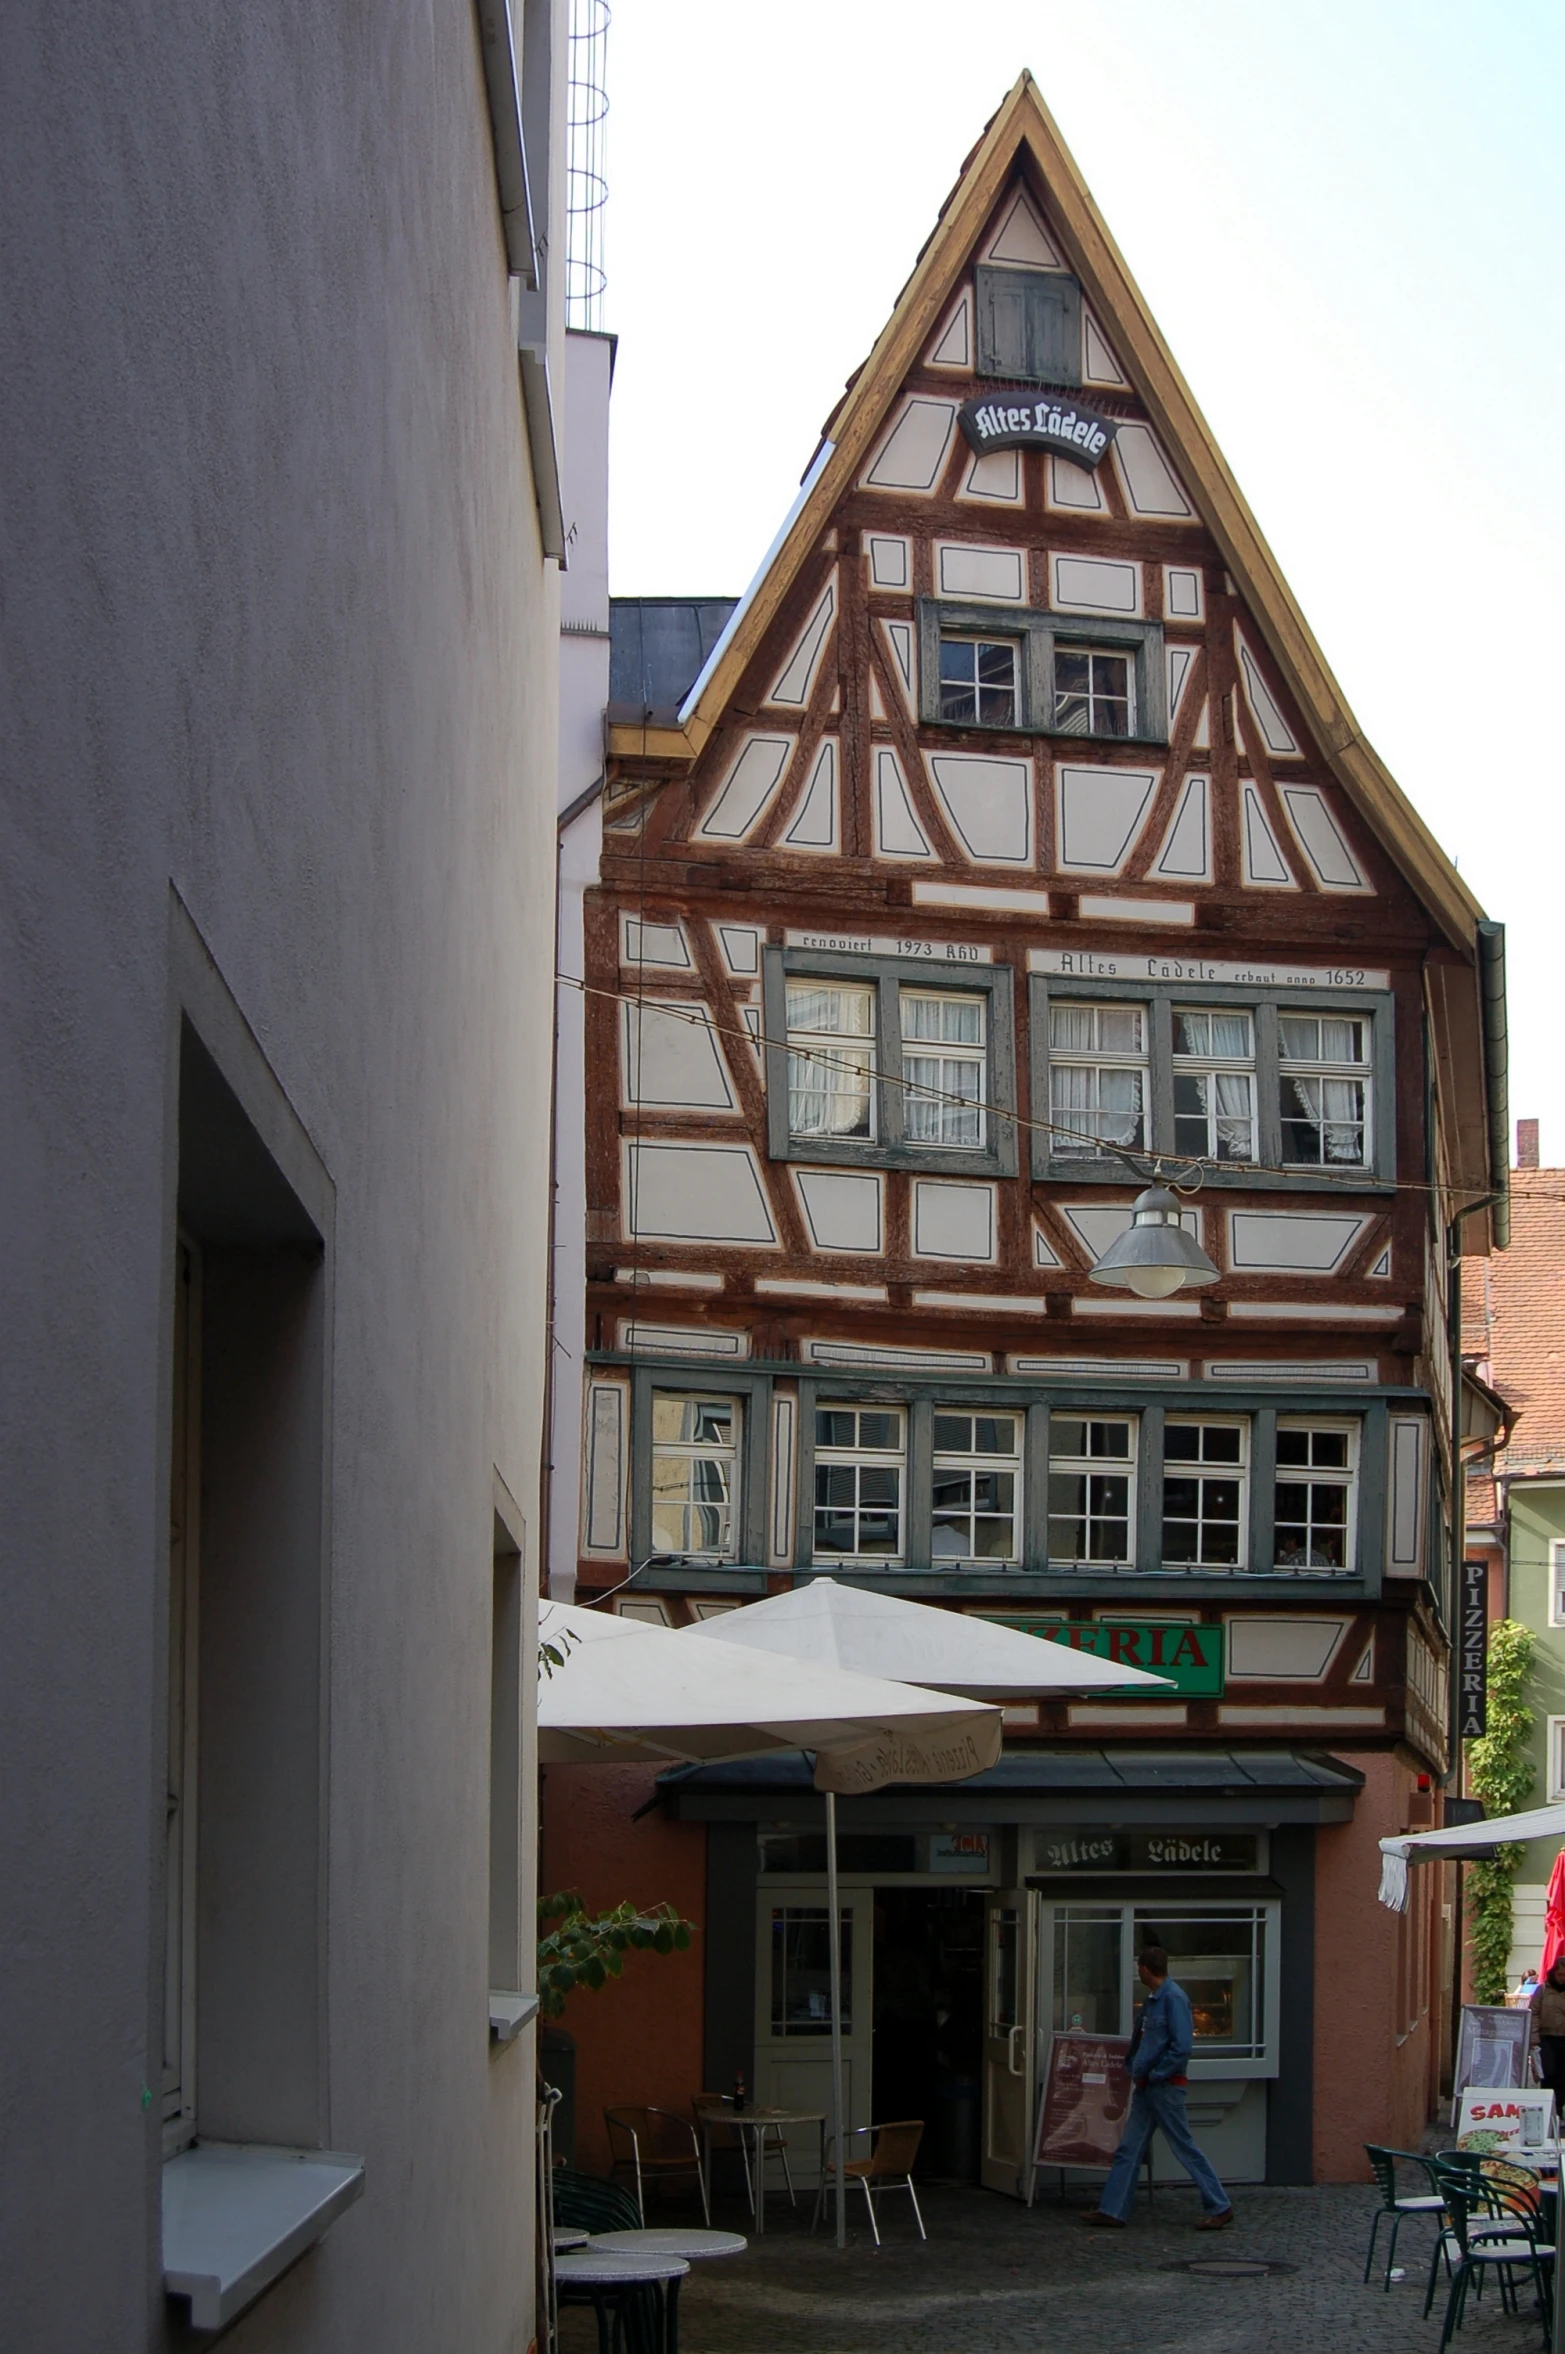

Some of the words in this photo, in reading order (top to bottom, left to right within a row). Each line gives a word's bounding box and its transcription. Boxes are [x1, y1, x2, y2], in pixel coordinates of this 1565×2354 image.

[975, 404, 1030, 438] Altes
[1033, 402, 1106, 454] Lädele
[803, 937, 871, 952] renoviert
[897, 940, 932, 956] 1973
[1234, 972, 1275, 983] erbaut
[1286, 977, 1316, 985] anno
[1326, 970, 1365, 986] 1652
[1462, 1566, 1484, 1734] PIZZERIA
[1047, 1836, 1113, 1867] Altes
[1148, 1838, 1222, 1862] Lädele
